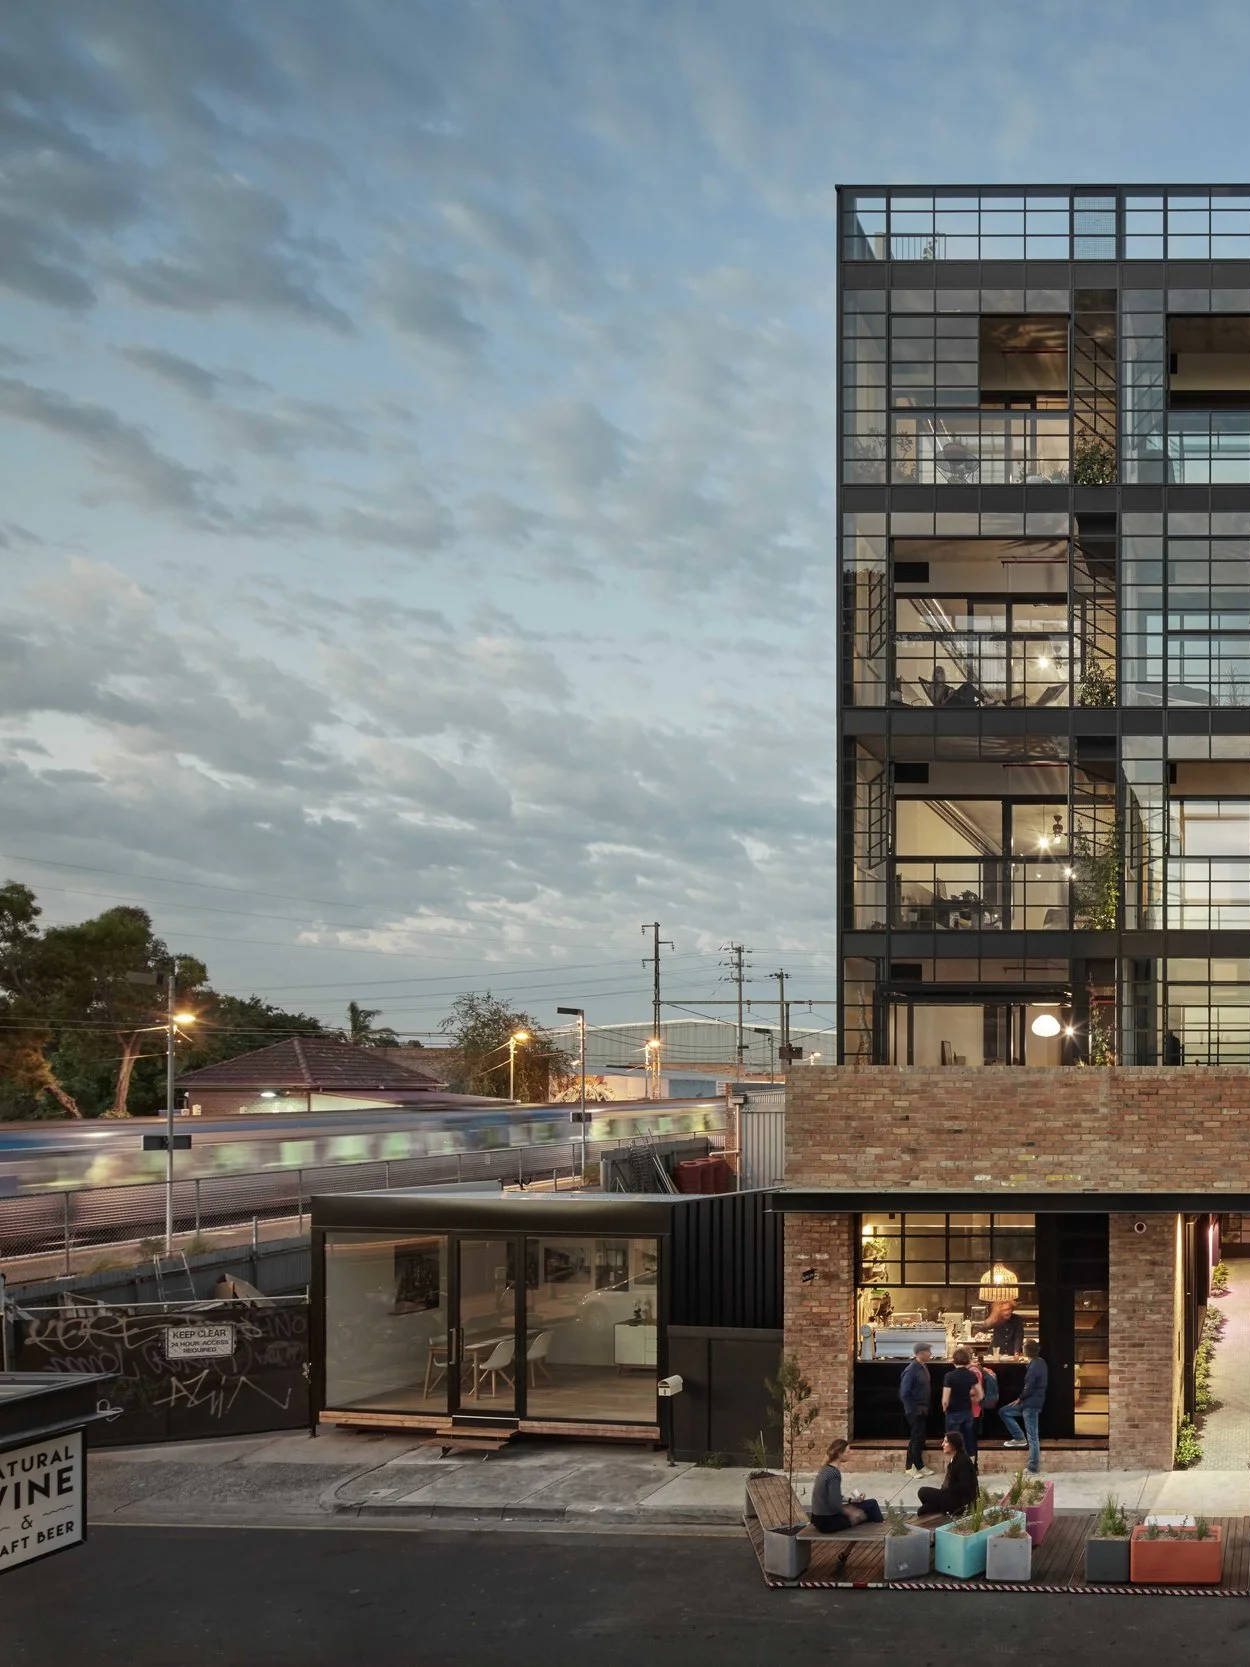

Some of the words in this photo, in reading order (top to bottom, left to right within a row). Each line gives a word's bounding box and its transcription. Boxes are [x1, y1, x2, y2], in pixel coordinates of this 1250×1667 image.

[173, 1330, 195, 1339] KEEP
[197, 1329, 226, 1338] CLEAR
[21, 1514, 33, 1530] &
[37, 1521, 74, 1544] BEER
